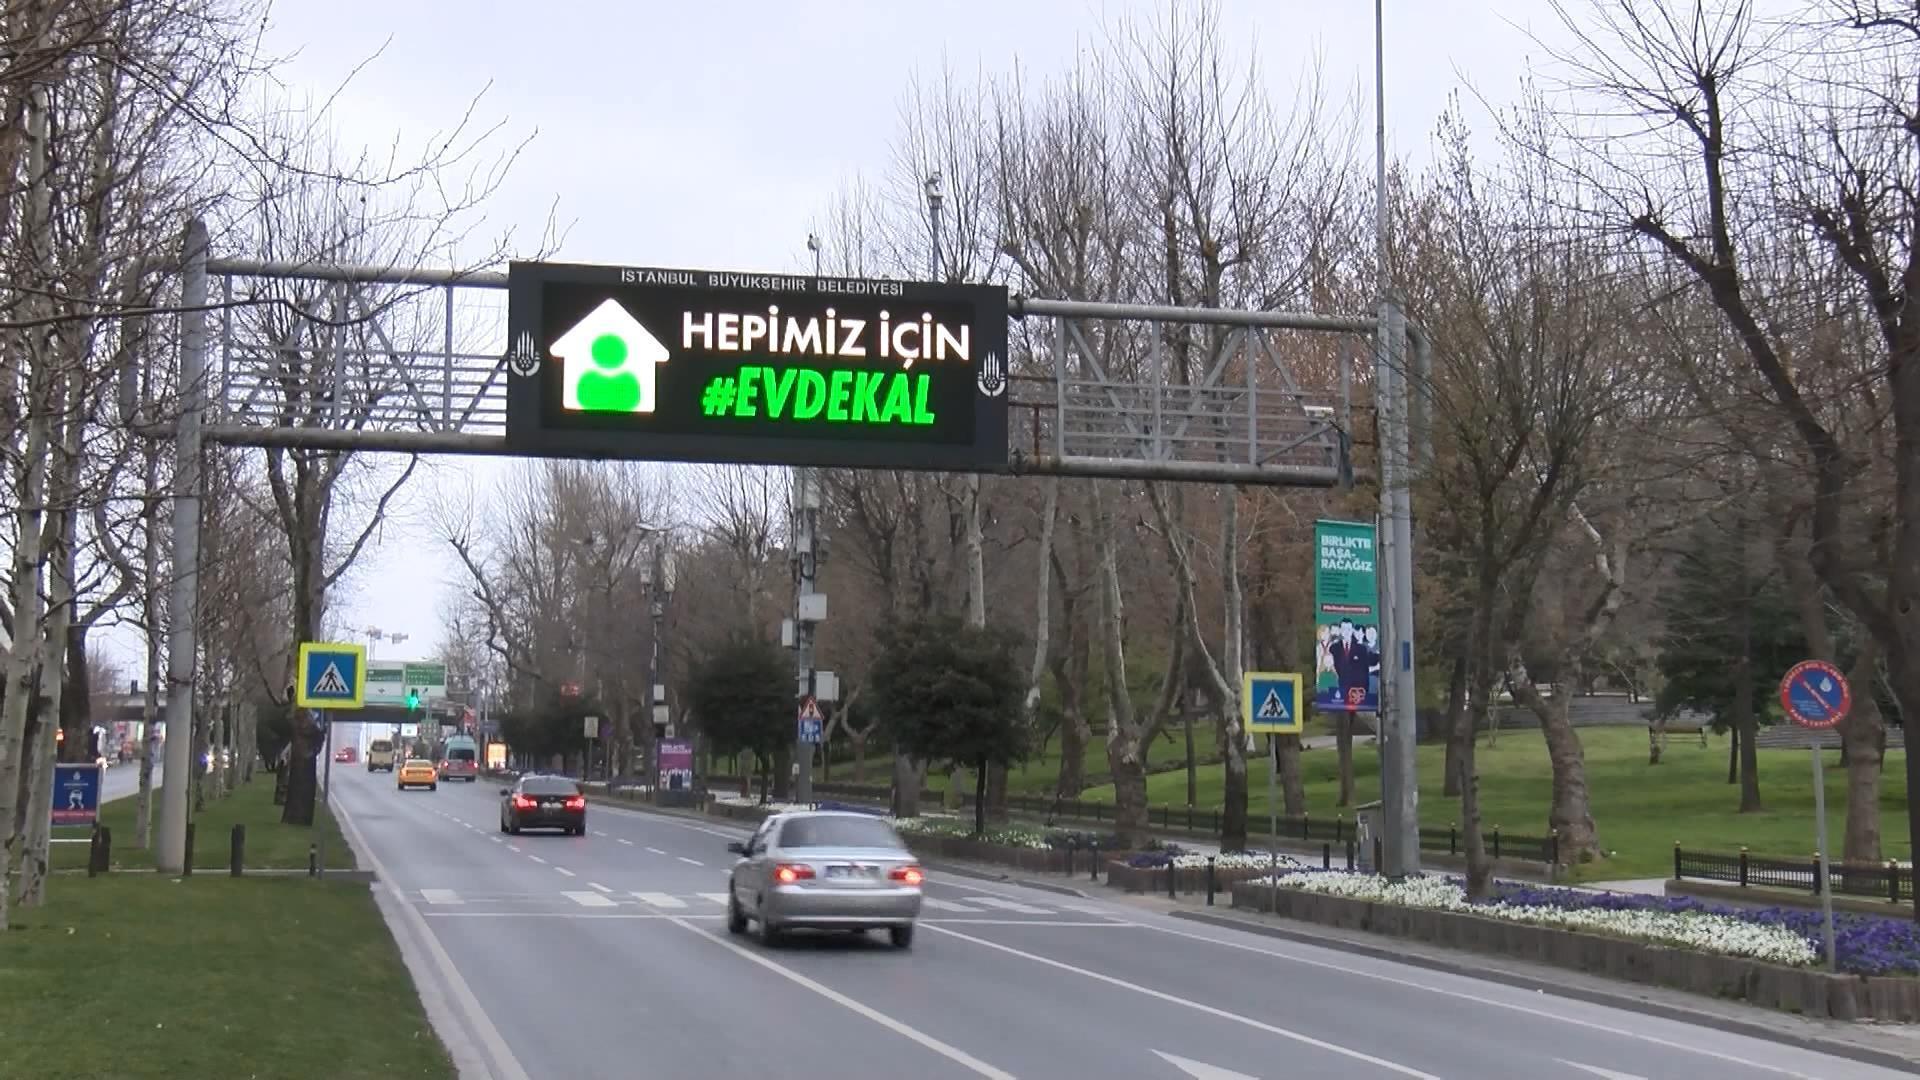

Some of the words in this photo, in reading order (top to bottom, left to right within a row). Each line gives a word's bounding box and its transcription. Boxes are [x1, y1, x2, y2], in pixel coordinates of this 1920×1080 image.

[621, 267, 697, 286] İSTANBUL
[817, 278, 904, 296] BELEDİYESİ
[682, 304, 867, 358] HEPİMİZ
[879, 309, 970, 370] İÇİN
[702, 366, 935, 425] #EVDEKAL
